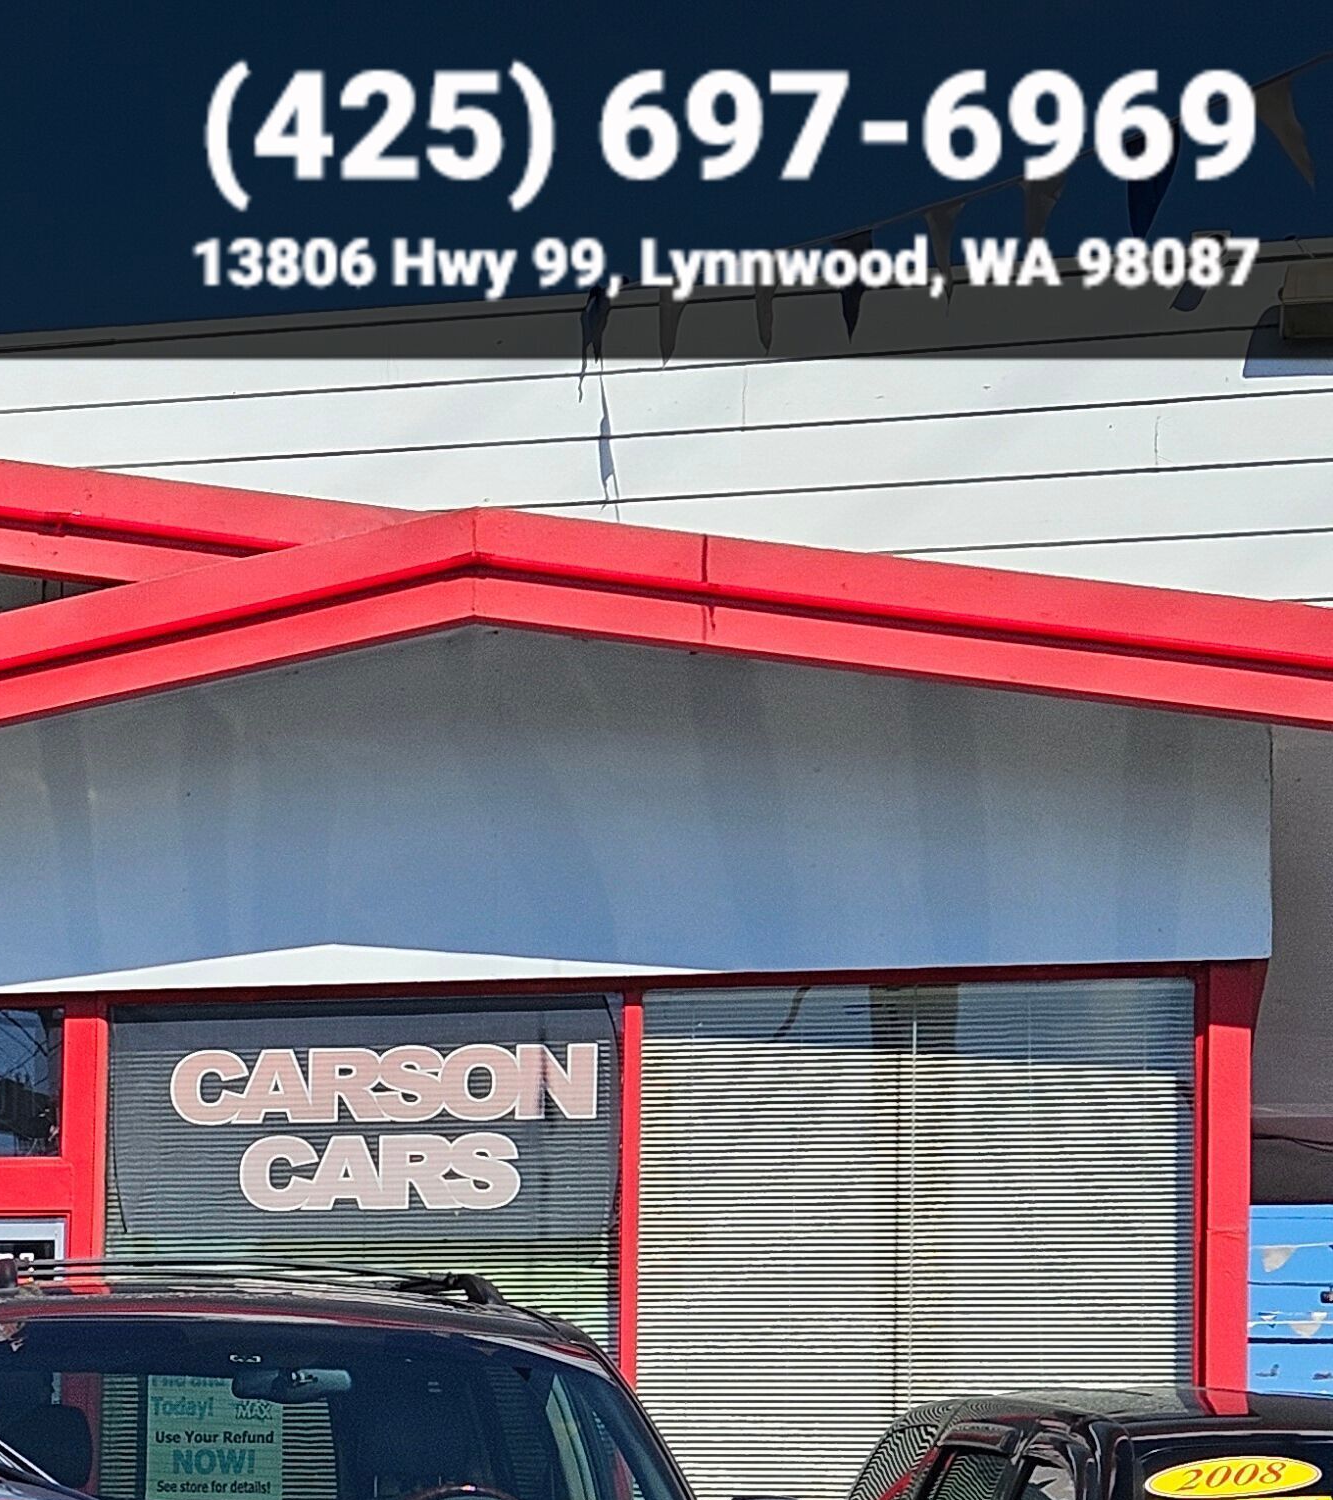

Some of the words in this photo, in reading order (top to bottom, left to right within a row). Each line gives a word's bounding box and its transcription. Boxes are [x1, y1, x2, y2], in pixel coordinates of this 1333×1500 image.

[169, 1041, 599, 1125] CARSON
[238, 1131, 522, 1212] CARS
[151, 1396, 214, 1419] Today!
[155, 1431, 181, 1444] Use
[185, 1430, 218, 1444] Your
[223, 1430, 275, 1444] Refund
[172, 1449, 256, 1475] NOW!
[157, 1480, 177, 1493] See
[180, 1481, 209, 1493] store
[211, 1480, 227, 1493] for
[230, 1480, 271, 1494] details!
[1175, 1462, 1287, 1492] 2008
